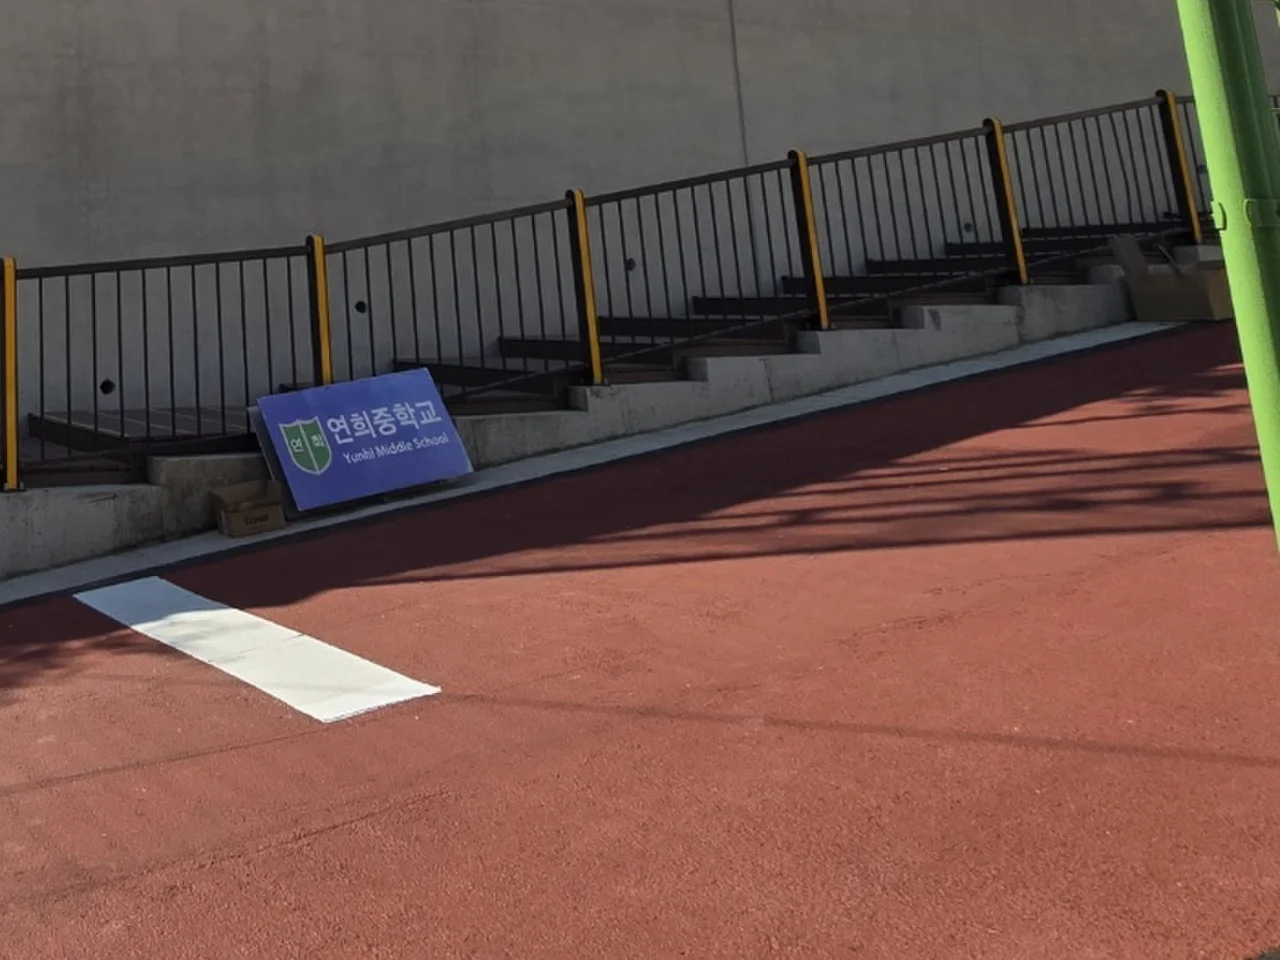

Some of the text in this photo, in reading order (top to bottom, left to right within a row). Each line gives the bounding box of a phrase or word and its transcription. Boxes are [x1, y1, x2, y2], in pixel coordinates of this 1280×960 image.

[327, 400, 442, 444] 연희중학교
[375, 440, 413, 457] Middle
[413, 432, 449, 450] School
